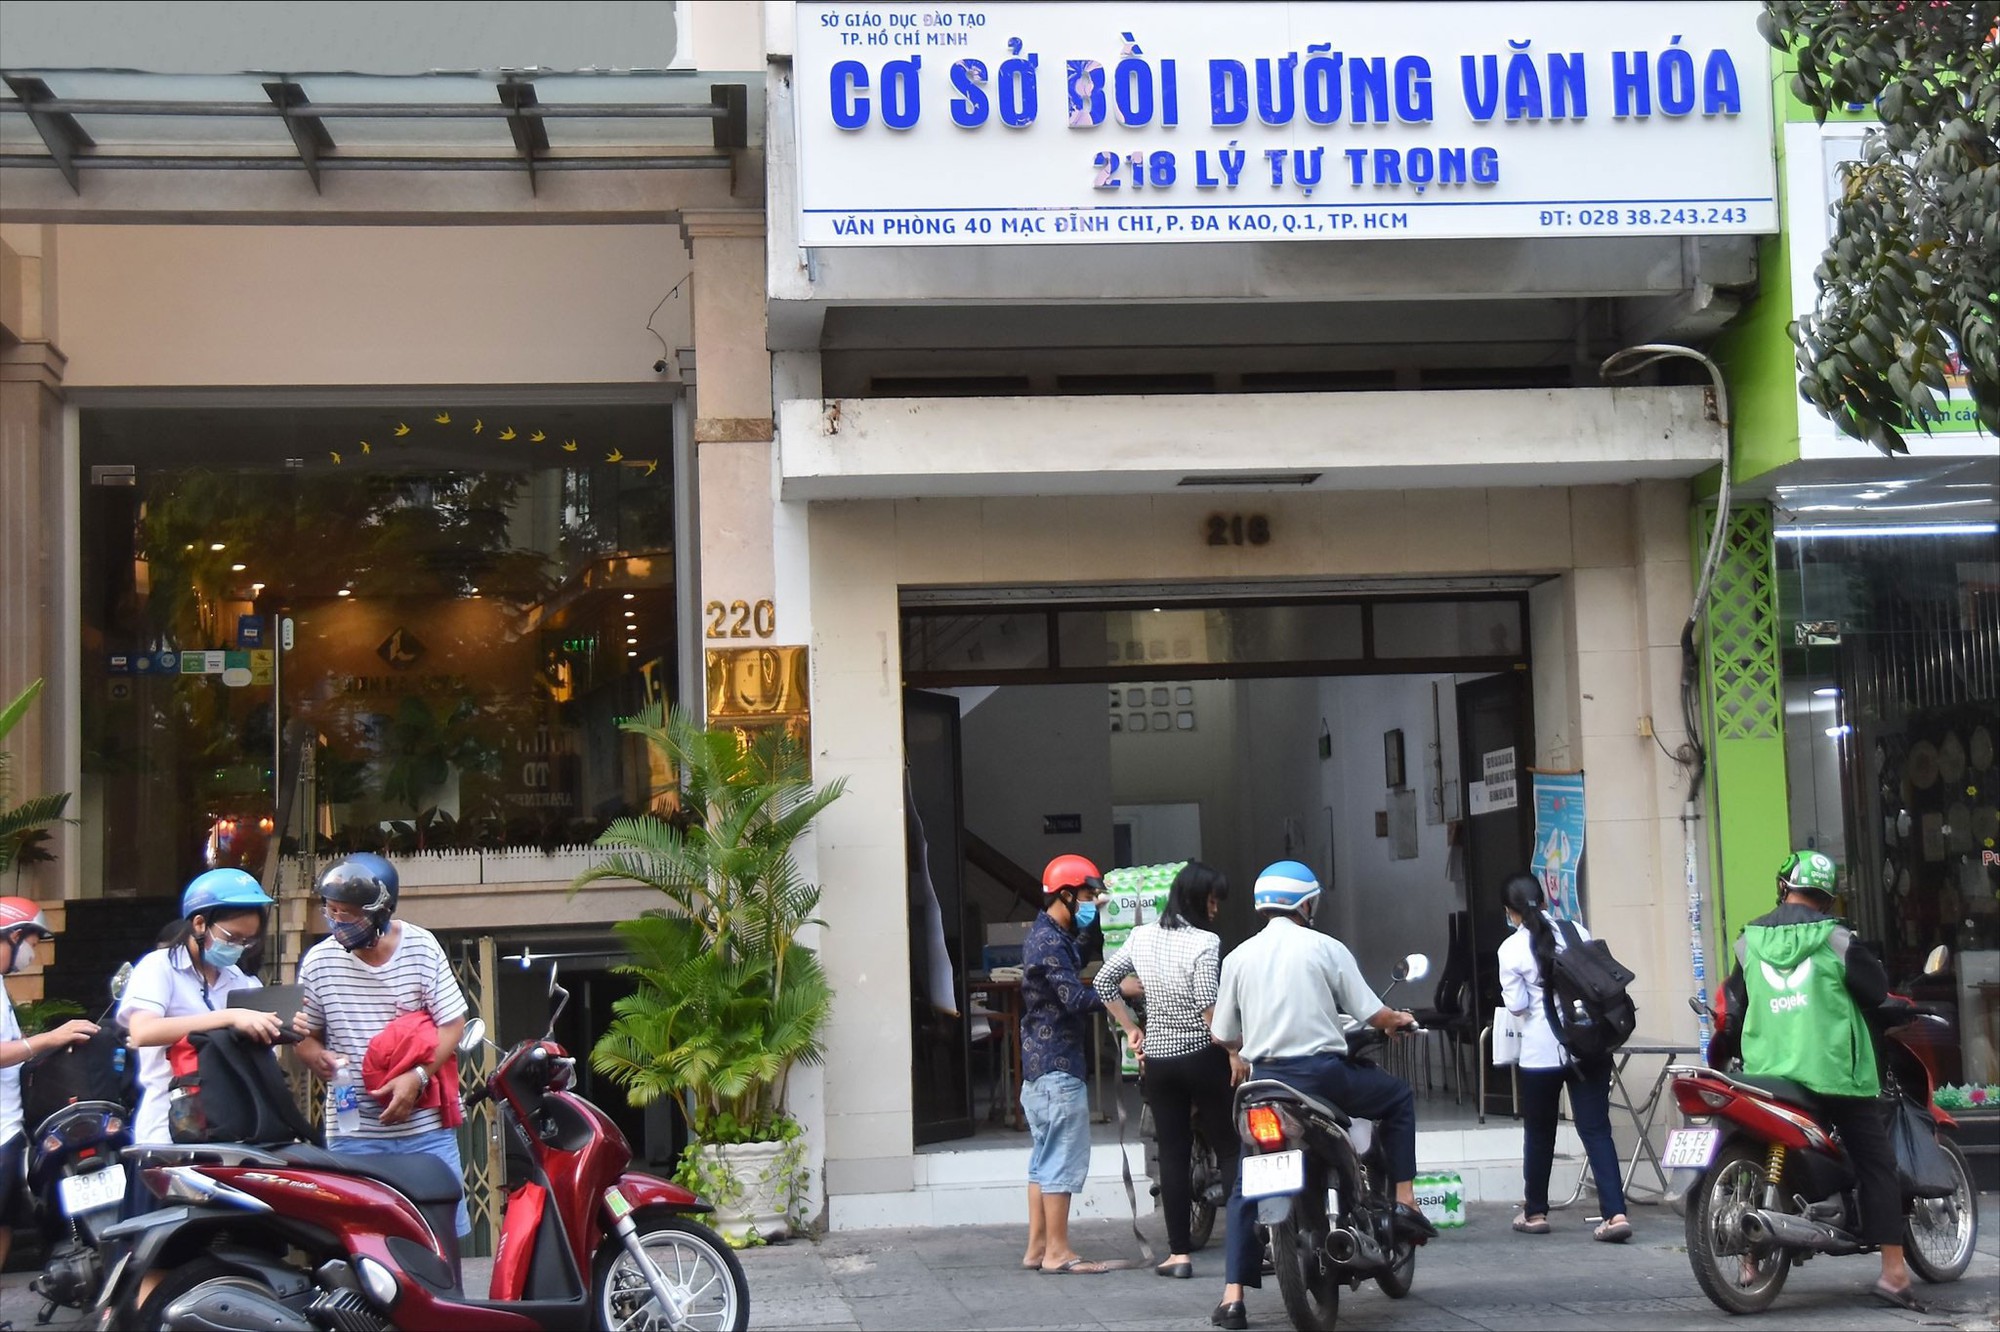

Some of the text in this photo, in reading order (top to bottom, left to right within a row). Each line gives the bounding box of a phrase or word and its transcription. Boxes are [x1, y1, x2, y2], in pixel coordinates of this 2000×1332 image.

[821, 10, 985, 29] SỞ GIÁO DỤC ĐÀO TẠO
[840, 28, 967, 45] TP. HỒ CHÍ MINH
[829, 31, 1742, 130] CƠ SỞ BỒI DƯỠNG VĂN HÓA
[1093, 140, 1500, 196] 218 LÝ TỰ TRỌNG
[831, 215, 874, 235] VĂN
[883, 215, 956, 235] PHÒNG
[964, 217, 992, 234] 40
[1001, 217, 1046, 237] MẠC
[1054, 213, 1109, 233] ĐĨNH
[1191, 215, 1220, 231] ĐA
[1327, 213, 1358, 229] TP.
[1363, 213, 1408, 229] HCM
[1539, 207, 1747, 226] ĐT: 028 38.243.243
[1207, 513, 1270, 546] 218
[706, 599, 775, 639] 220
[1770, 991, 1808, 1013] gojek
